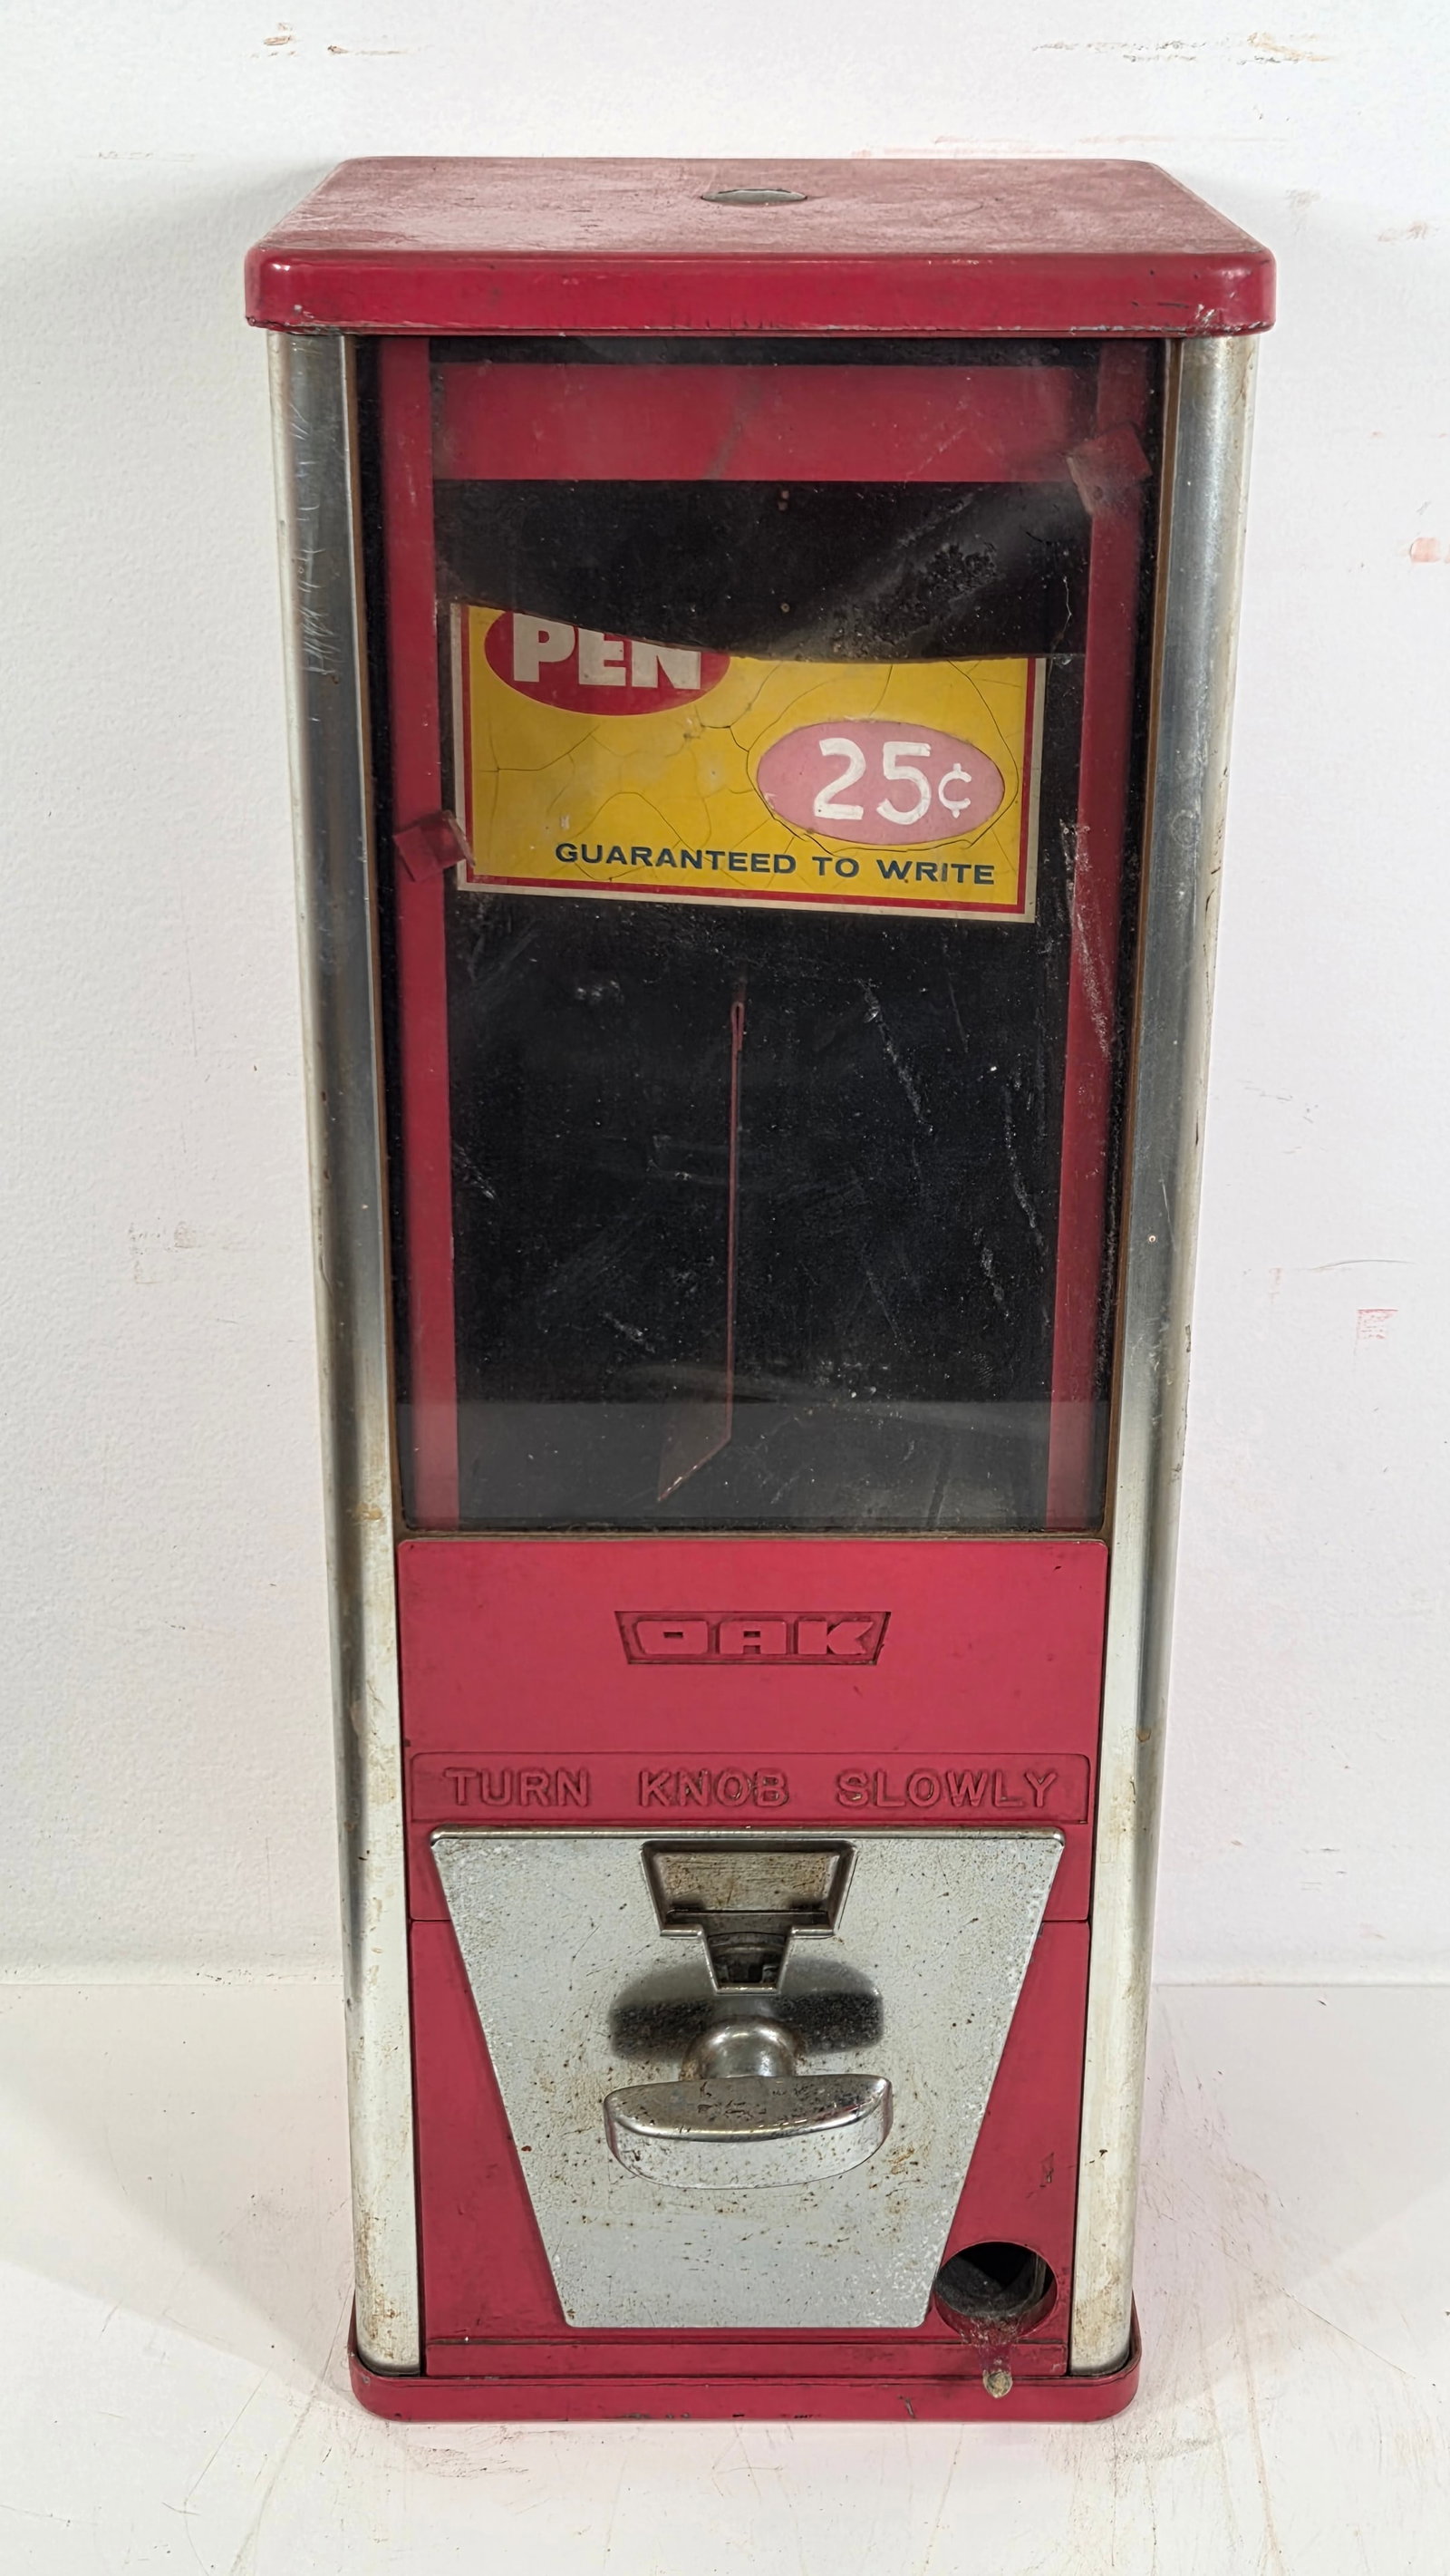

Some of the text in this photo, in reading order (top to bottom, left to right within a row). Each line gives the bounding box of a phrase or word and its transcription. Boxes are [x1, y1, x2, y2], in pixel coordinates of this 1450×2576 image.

[814, 737, 972, 825] 25¢
[555, 842, 995, 885] GUARANTEED TO WRITE
[633, 1618, 875, 1657] OAK
[443, 1767, 1059, 1808] TURN KNOB SLOWLY
